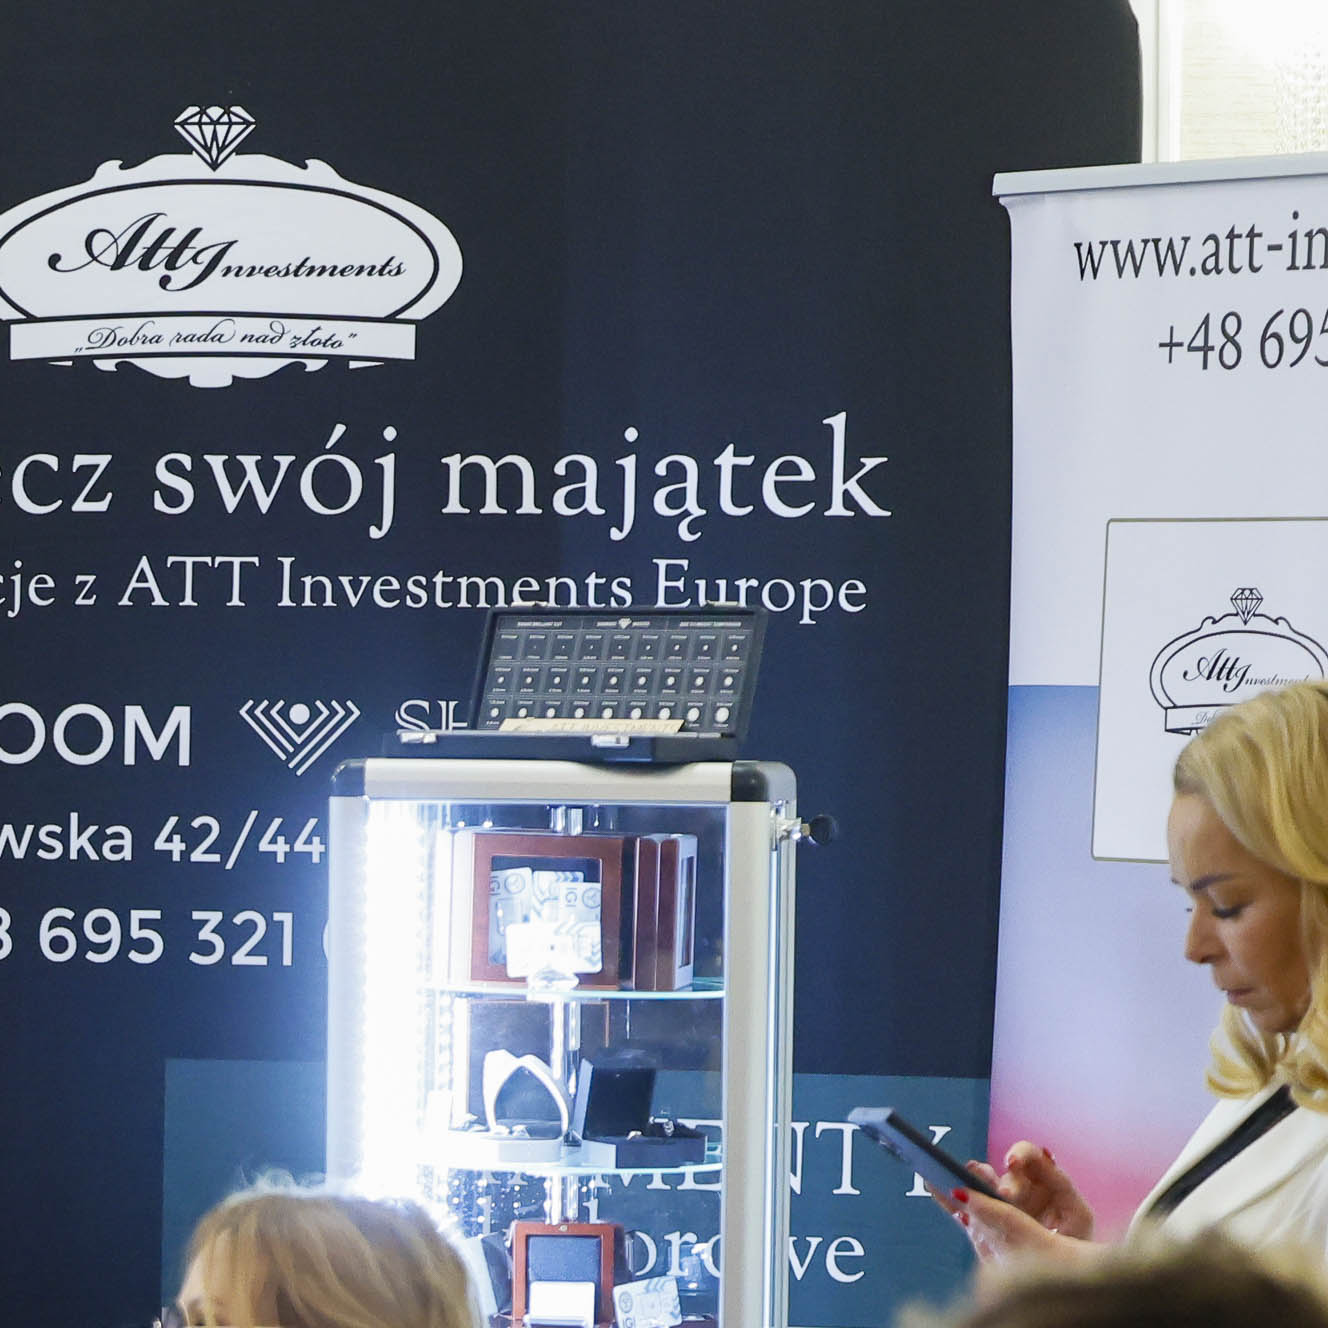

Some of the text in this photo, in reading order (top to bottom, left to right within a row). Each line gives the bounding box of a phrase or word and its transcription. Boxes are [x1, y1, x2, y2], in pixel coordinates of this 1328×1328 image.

[171, 318, 236, 345] rada
[240, 319, 286, 347] nad
[1158, 312, 1243, 371] +48
[152, 423, 398, 540] swój
[441, 411, 893, 541] majątek
[74, 574, 98, 606] z
[118, 554, 261, 607] ATT
[276, 556, 634, 611] Investments
[652, 558, 868, 624] Europe
[154, 809, 326, 871] 42/44
[38, 907, 164, 965] 695
[188, 910, 295, 967] 321
